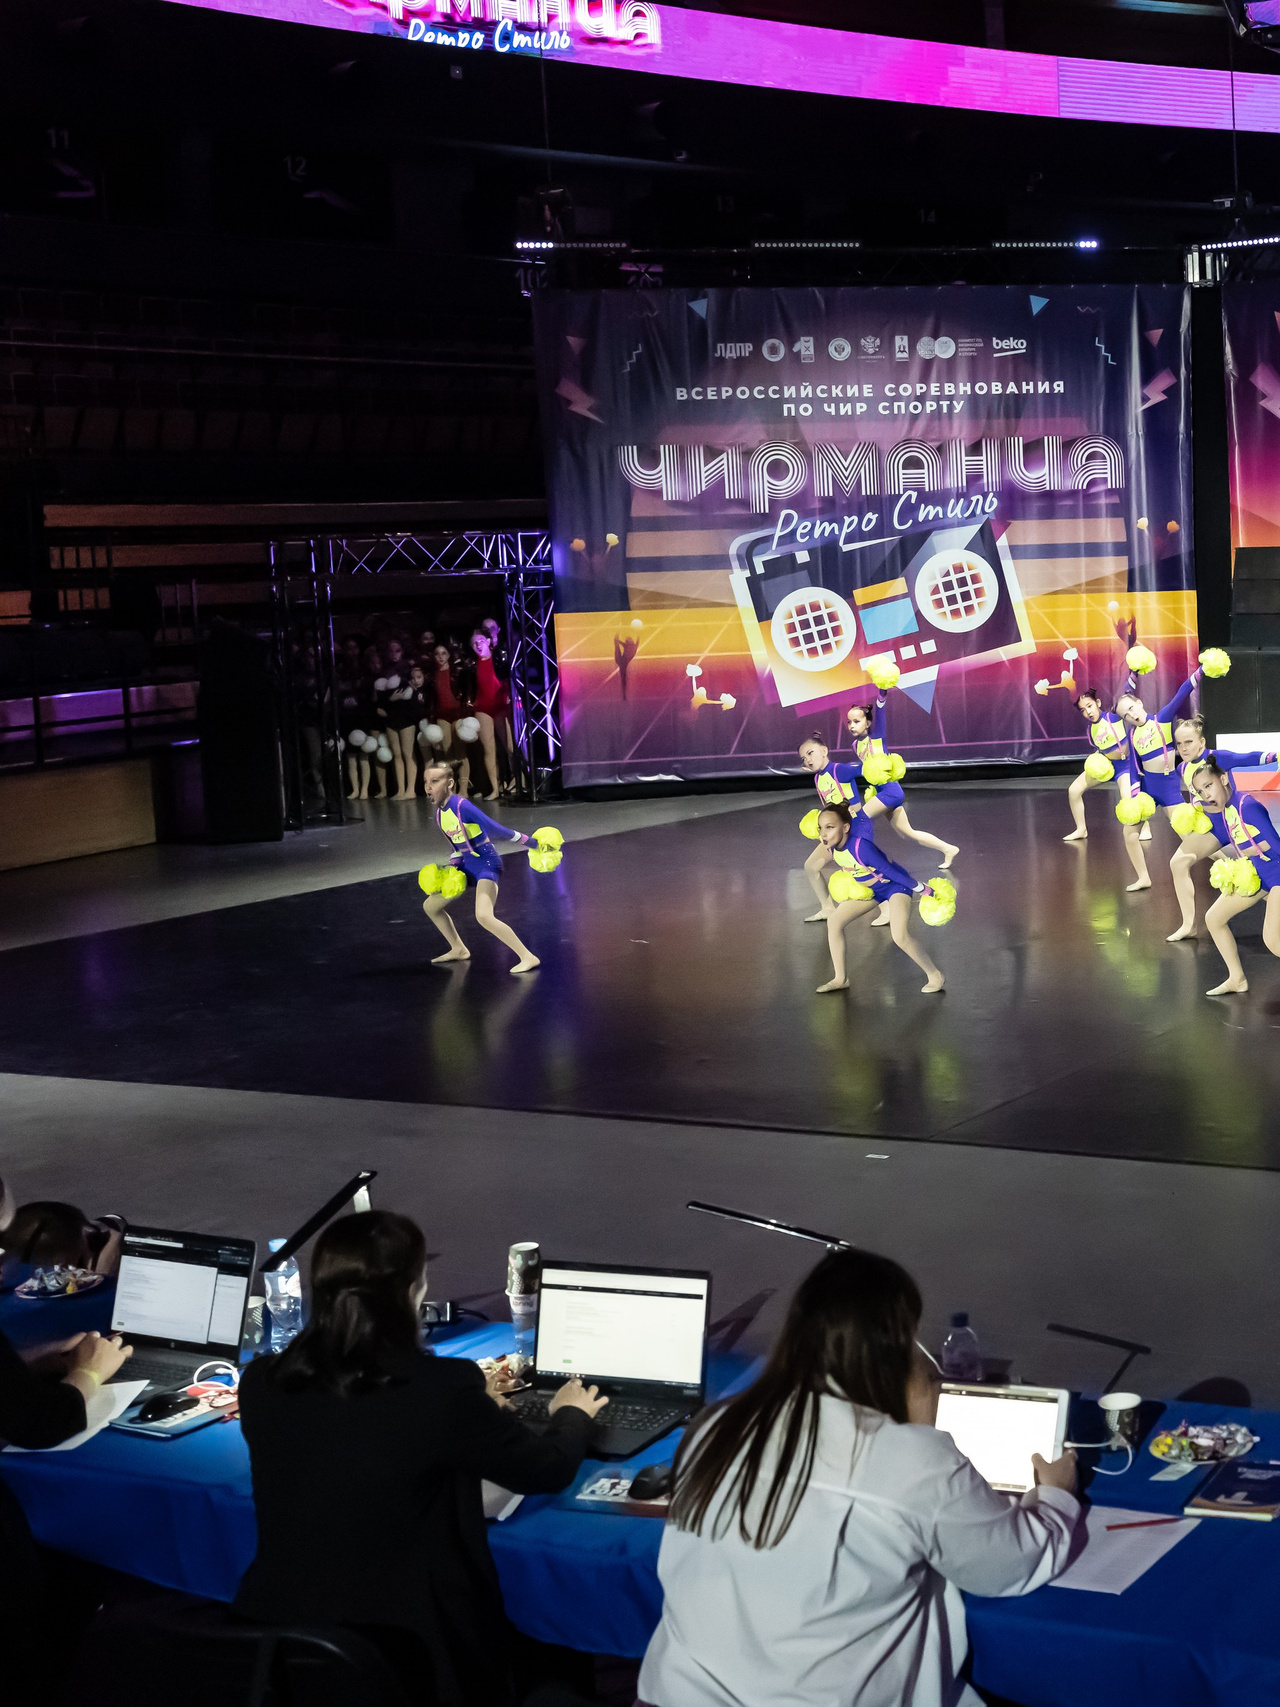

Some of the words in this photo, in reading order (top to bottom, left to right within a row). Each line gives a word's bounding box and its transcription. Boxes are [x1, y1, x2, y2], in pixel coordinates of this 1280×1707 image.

[714, 342, 753, 360] ЛДПР
[992, 336, 1028, 350] beko
[676, 382, 874, 401] ВСЕРОССИЙСКИЕ
[884, 380, 1066, 397] СОРЕВНОВАНИЯ
[783, 403, 813, 417] ПО
[823, 402, 868, 416] ЧИР
[878, 400, 965, 415] СПОРТУ
[772, 508, 879, 552] Ретро
[892, 490, 998, 530] Стиль
